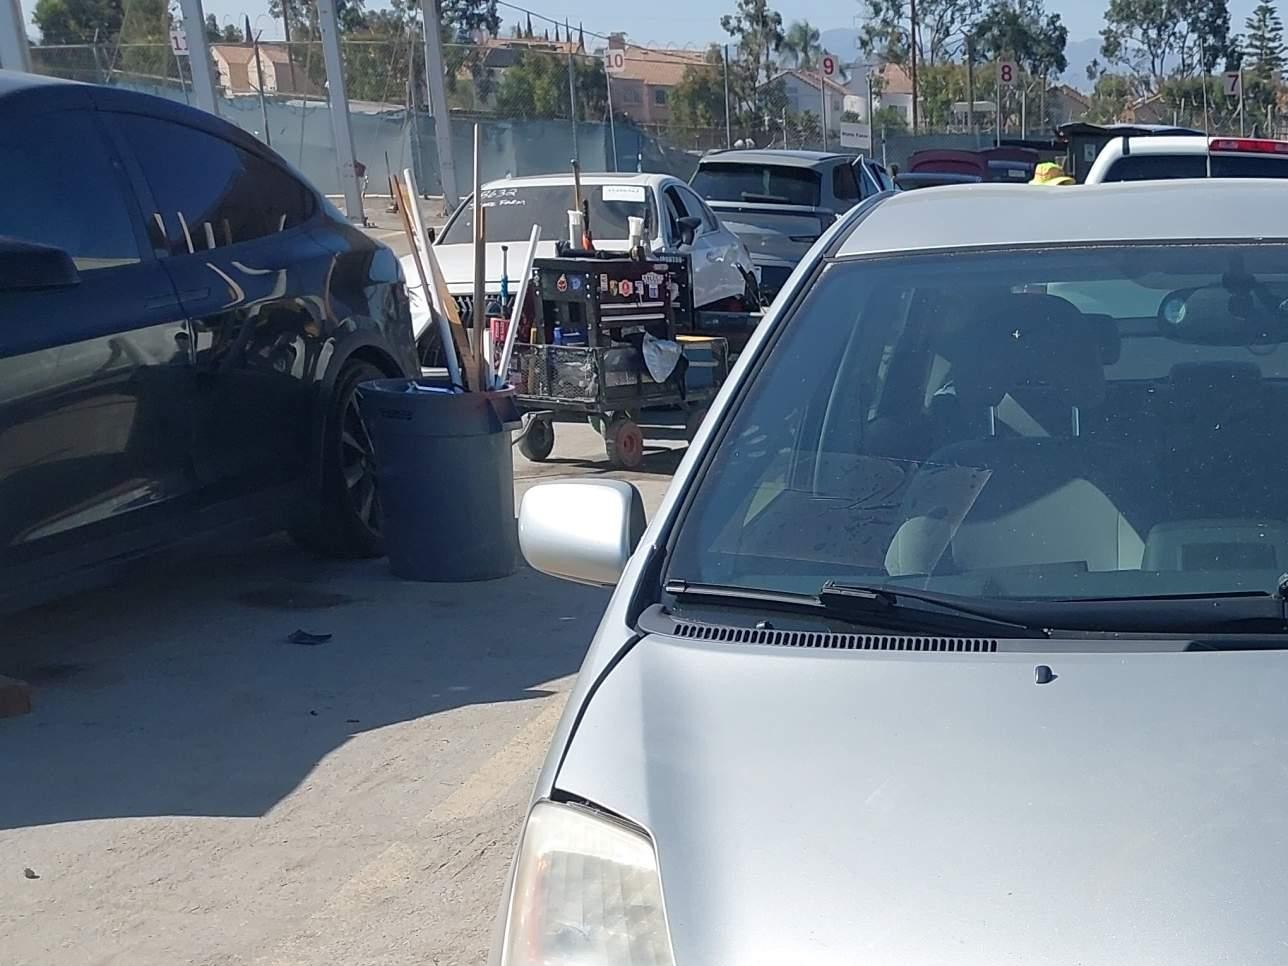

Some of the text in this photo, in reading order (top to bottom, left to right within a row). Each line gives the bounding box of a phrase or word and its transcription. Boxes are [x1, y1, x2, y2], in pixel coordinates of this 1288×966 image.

[606, 54, 623, 68] 10
[823, 57, 834, 75] 9
[1001, 64, 1012, 82] 8
[1227, 74, 1240, 92] 7
